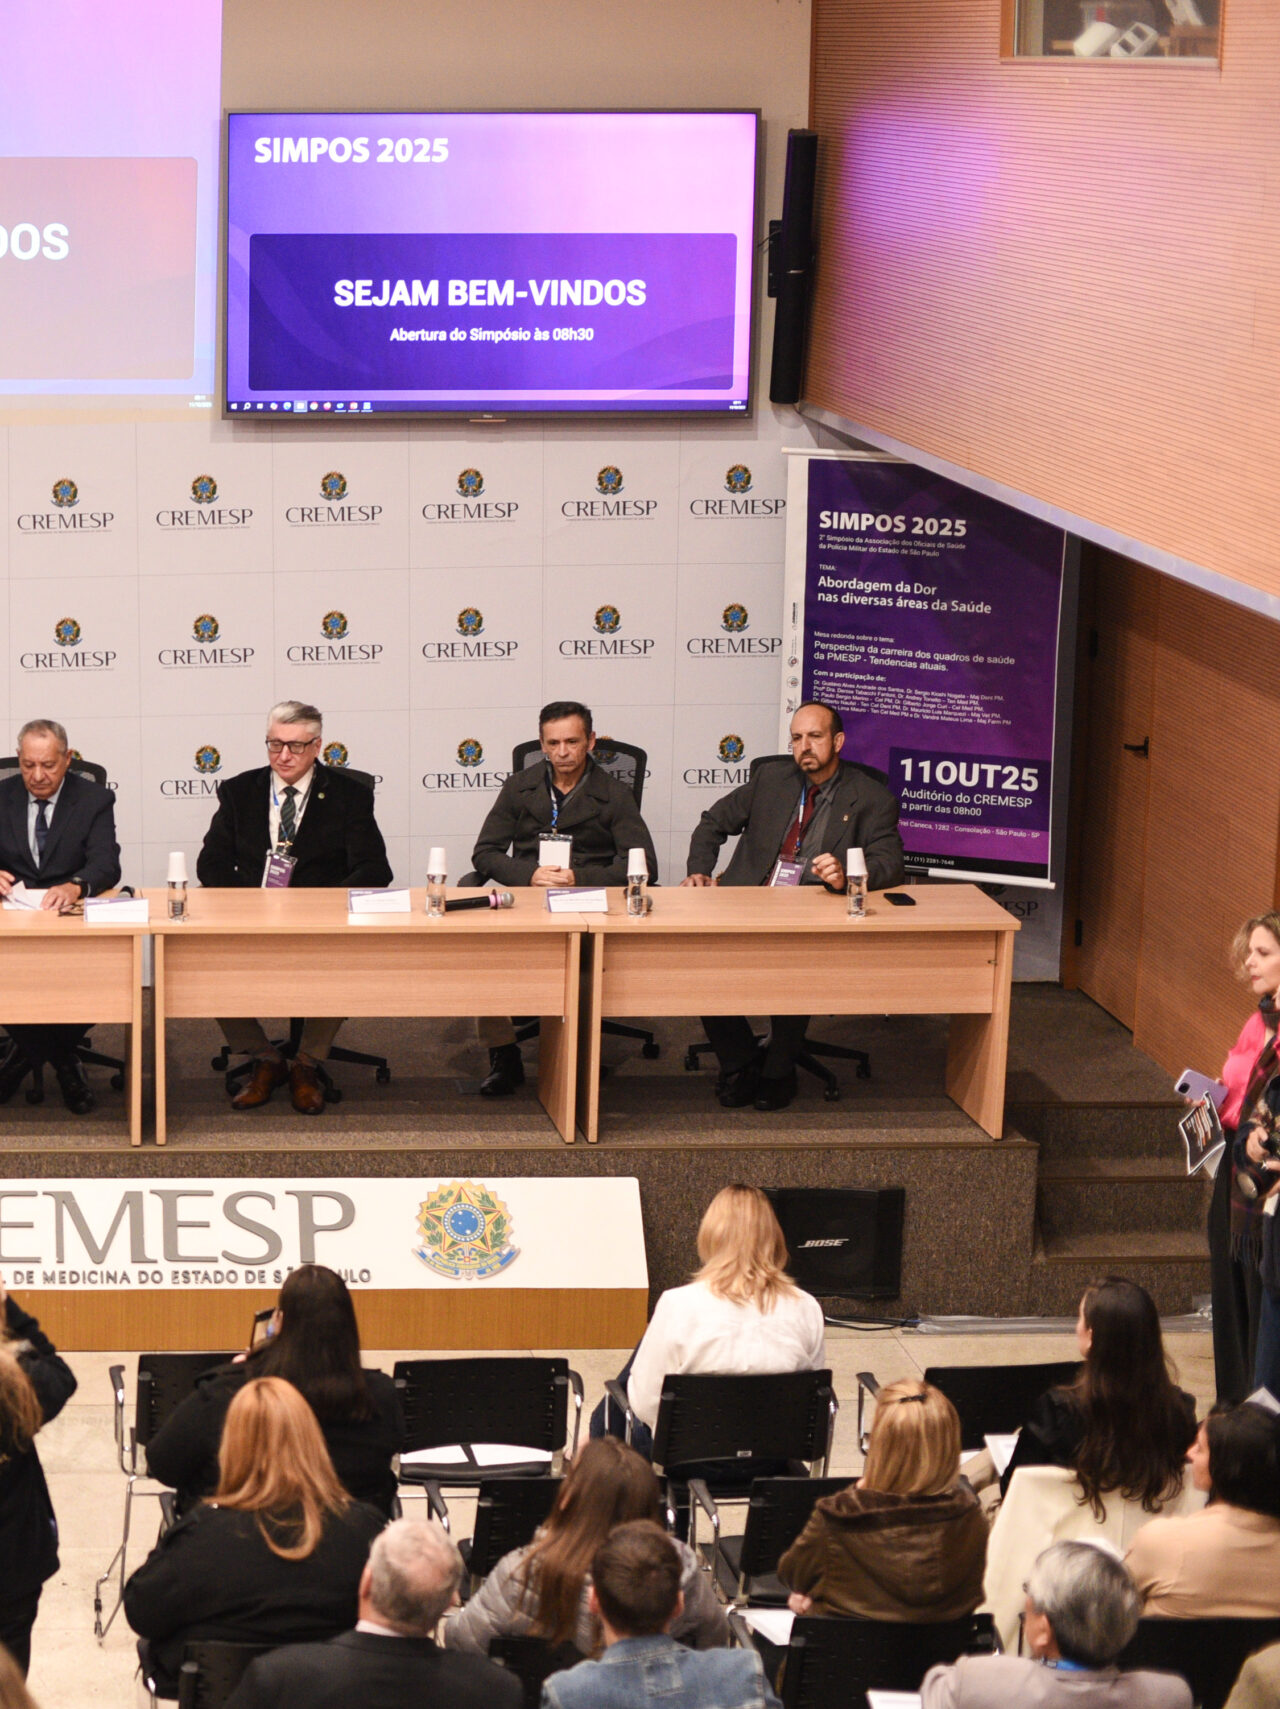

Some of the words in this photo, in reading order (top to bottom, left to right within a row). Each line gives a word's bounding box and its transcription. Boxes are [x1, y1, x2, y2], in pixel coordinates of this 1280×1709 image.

[255, 137, 370, 163] SIMPOS
[377, 138, 449, 163] 2025
[334, 280, 439, 306] SEJAM
[448, 279, 646, 306] BEM-VINDOS
[390, 328, 447, 341] Abertura
[450, 328, 467, 341] do
[470, 328, 531, 343] Simpósio
[534, 328, 550, 340] às
[553, 328, 594, 340] 08h30
[286, 506, 382, 522] CREMESP
[423, 503, 518, 519] CREMESP
[562, 501, 657, 516] CREMESP
[690, 499, 786, 514] CREMESP
[17, 513, 114, 529] CREMESP
[156, 509, 253, 525] CREMESP
[819, 511, 906, 533] SIMPOS
[912, 517, 966, 537] 2025
[818, 576, 891, 592] Abordagem
[895, 581, 911, 593] da
[914, 583, 937, 595] Dor
[818, 593, 838, 602] nas
[841, 592, 893, 606] diversas
[896, 596, 928, 609] áreas
[931, 599, 947, 611] da
[951, 600, 991, 614] Saúde
[287, 645, 382, 661] CREMESP
[423, 642, 518, 658] CREMESP
[559, 640, 654, 655] CREMESP
[687, 638, 782, 653] CREMESP
[815, 641, 864, 653] Perspectiva
[868, 645, 878, 653] da
[881, 648, 913, 657] carreira
[915, 650, 931, 659] dos
[934, 652, 970, 663] quadros
[973, 654, 984, 663] de
[987, 655, 1015, 665] saúde
[20, 652, 116, 667] CREMESP
[159, 648, 254, 664] CREMESP
[814, 652, 824, 660] da
[827, 652, 861, 663] PMESP
[870, 656, 917, 668] Tendencias
[920, 662, 948, 671] atuais.
[835, 672, 874, 681] participação
[422, 772, 512, 790] CREMES
[901, 758, 1038, 792] 11OUT25
[902, 788, 952, 802] Auditório
[956, 792, 970, 803] do
[974, 794, 1032, 808] CREMESP
[909, 803, 932, 812] partir
[935, 805, 951, 813] das
[953, 806, 982, 816] 08h00
[798, 1239, 849, 1248] BOSE
[14, 1271, 34, 1284] DE
[43, 1270, 130, 1284] MEDICINA
[138, 1270, 163, 1284] DO
[172, 1270, 238, 1284] ESTADO
[245, 1270, 266, 1283] DE
